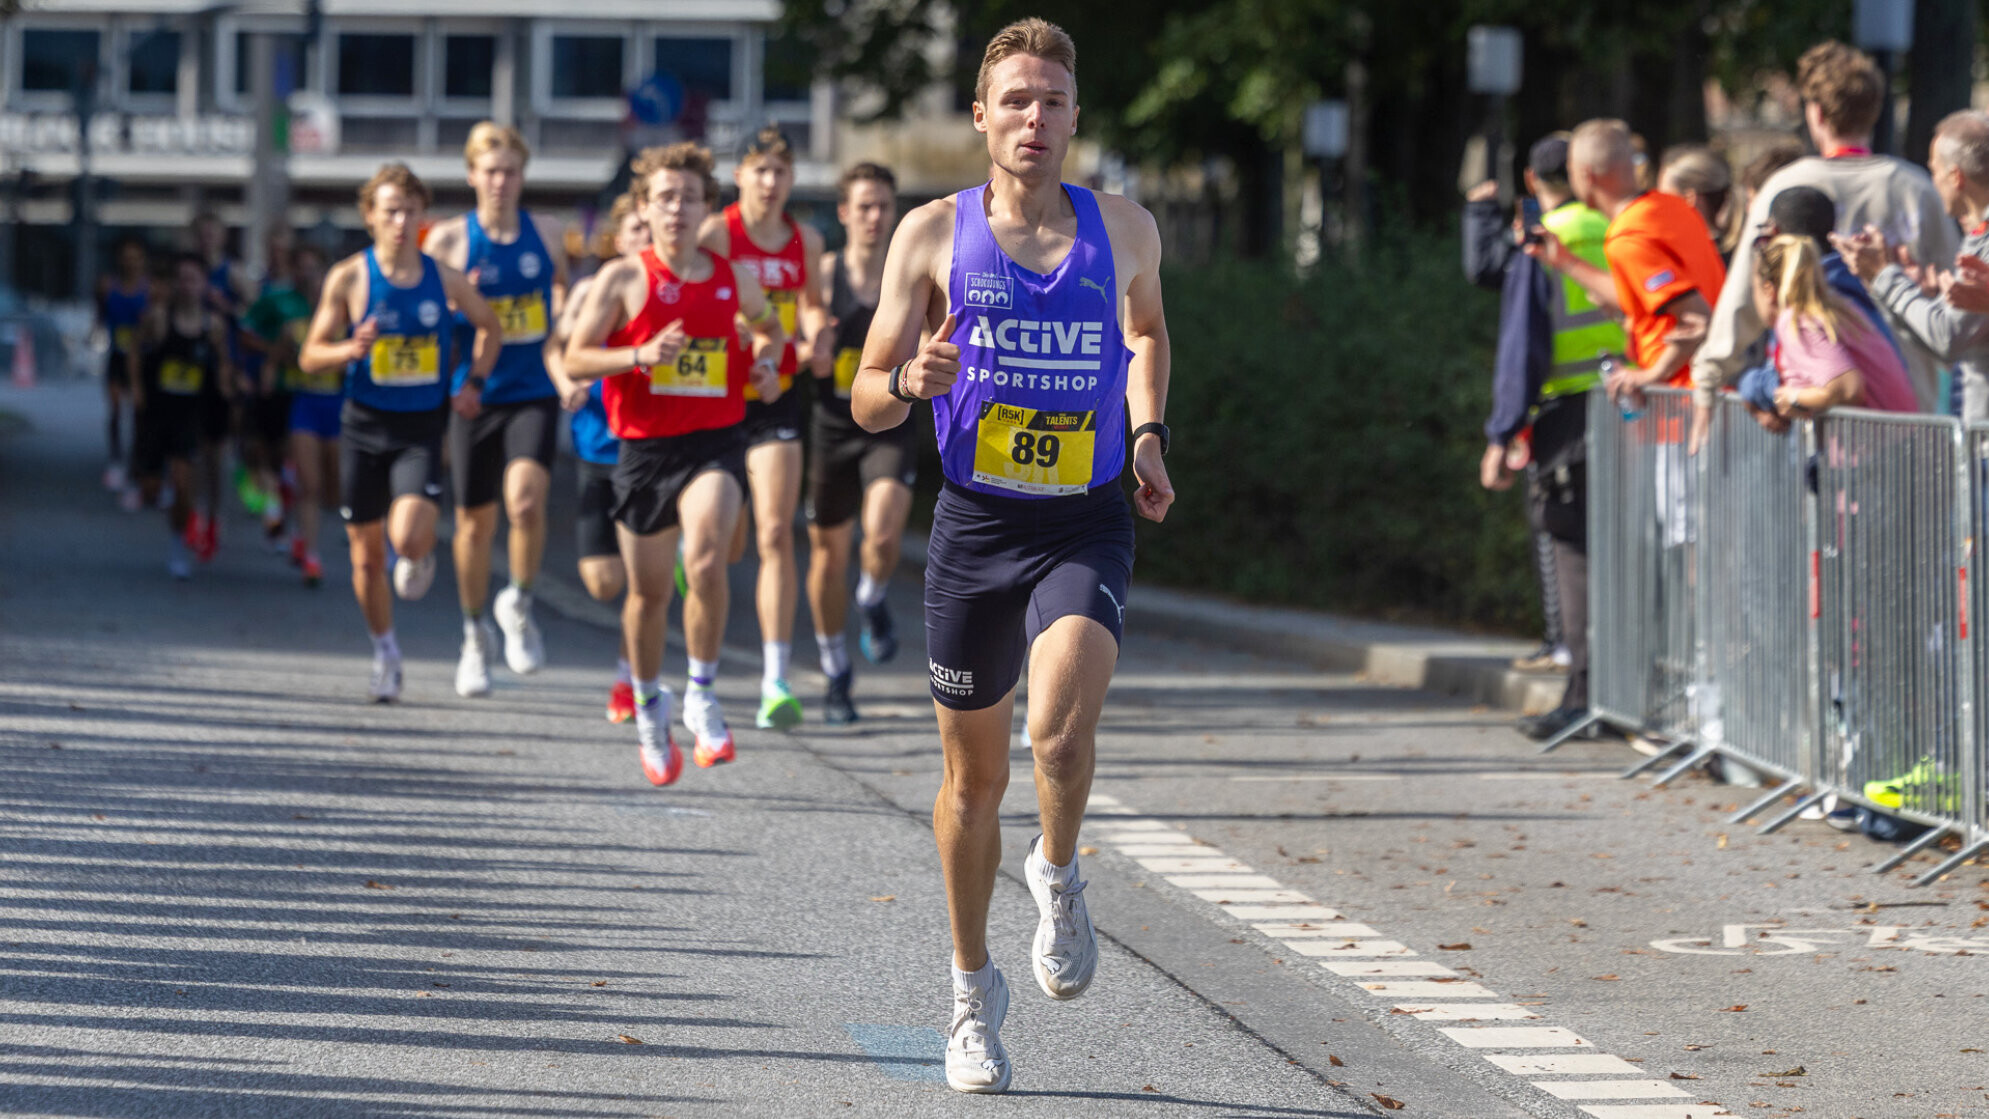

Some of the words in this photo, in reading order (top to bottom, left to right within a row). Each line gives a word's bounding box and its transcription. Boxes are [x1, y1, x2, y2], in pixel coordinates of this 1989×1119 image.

[968, 315, 1103, 355] ACTiVE
[677, 354, 707, 377] 64
[966, 366, 1098, 391] SPORTSHOP
[1045, 416, 1078, 426] TALENTS
[1011, 431, 1060, 468] 89
[930, 675, 974, 696] ORTSHOP
